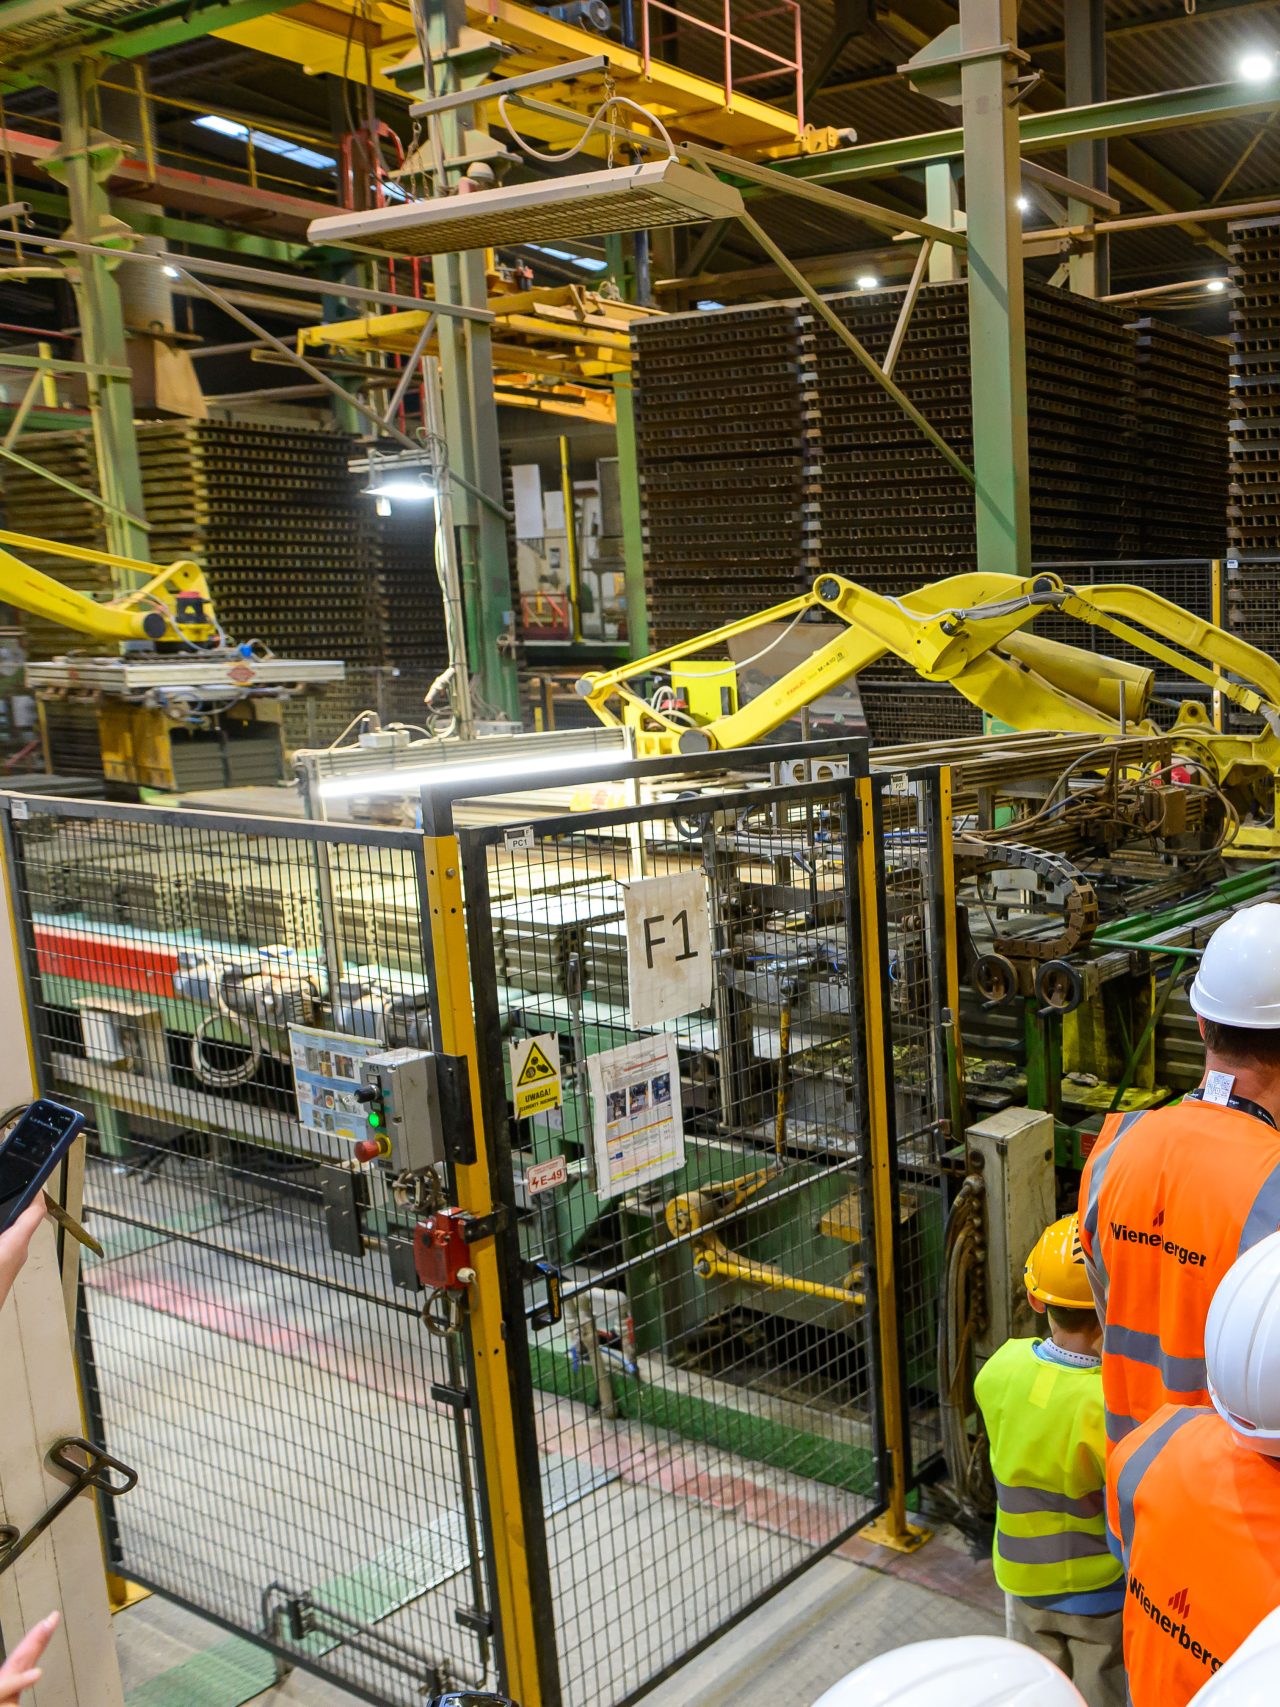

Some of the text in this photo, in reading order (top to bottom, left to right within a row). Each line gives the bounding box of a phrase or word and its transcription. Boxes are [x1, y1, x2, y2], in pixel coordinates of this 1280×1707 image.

[513, 839, 527, 847] PC1
[644, 910, 698, 969] F1
[525, 1088, 551, 1102] UWAGA!
[1110, 1221, 1207, 1267] Wieneerger
[1129, 1574, 1224, 1675] Wienerberg
